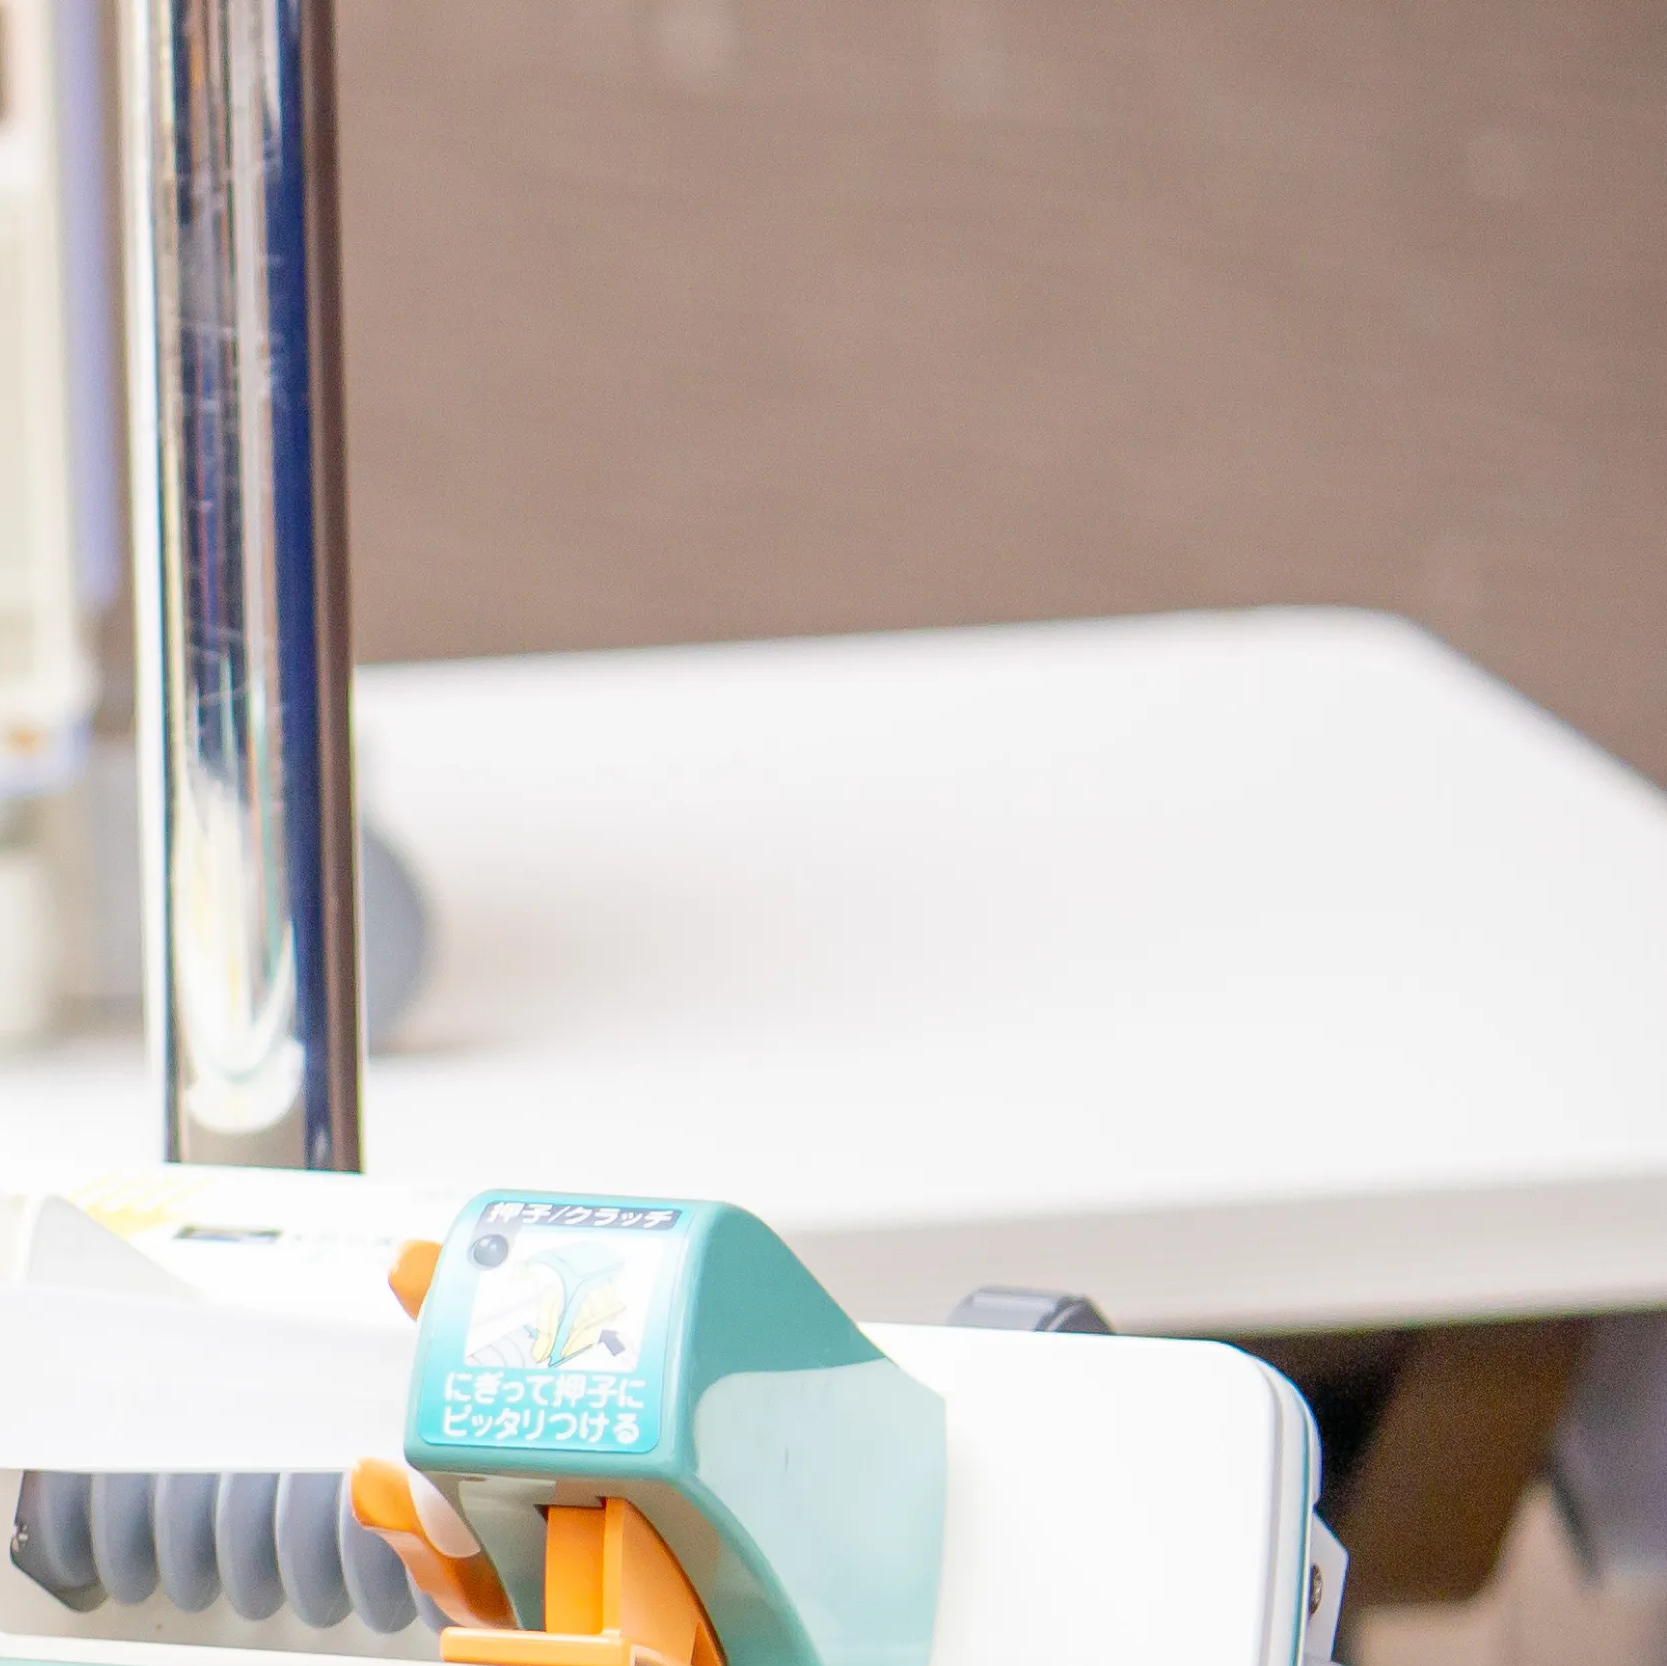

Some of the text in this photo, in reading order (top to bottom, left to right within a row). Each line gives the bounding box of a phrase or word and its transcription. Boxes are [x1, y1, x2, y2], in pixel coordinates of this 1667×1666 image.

[443, 1370, 647, 1410] にぎって押子に
[442, 1403, 641, 1445] ピッタリつける
